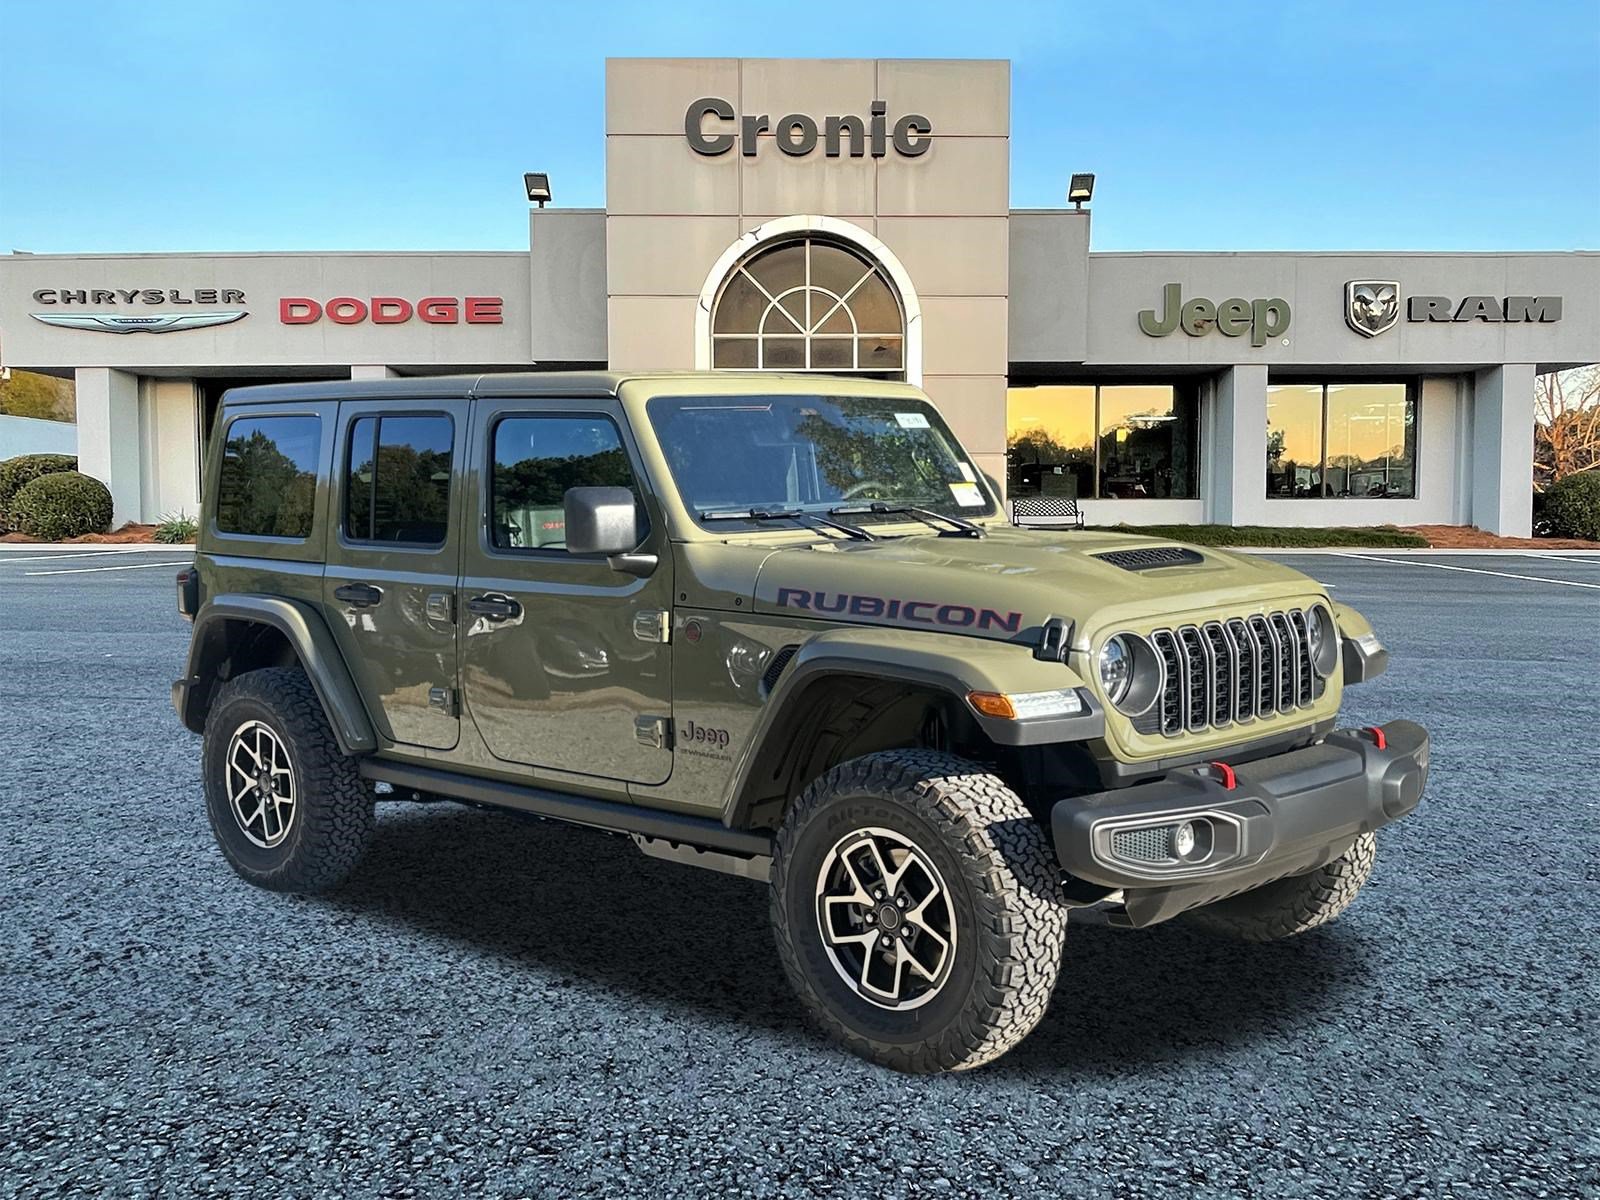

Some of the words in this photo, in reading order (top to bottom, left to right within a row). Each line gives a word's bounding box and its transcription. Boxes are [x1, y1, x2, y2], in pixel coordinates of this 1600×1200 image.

[685, 97, 932, 157] Cronic
[32, 288, 248, 305] CHRYSLER
[279, 297, 503, 324] DODGE
[1407, 296, 1563, 323] RAM
[1138, 283, 1291, 347] Jeep
[776, 588, 1023, 632] RUBICON
[680, 720, 730, 750] Jeep
